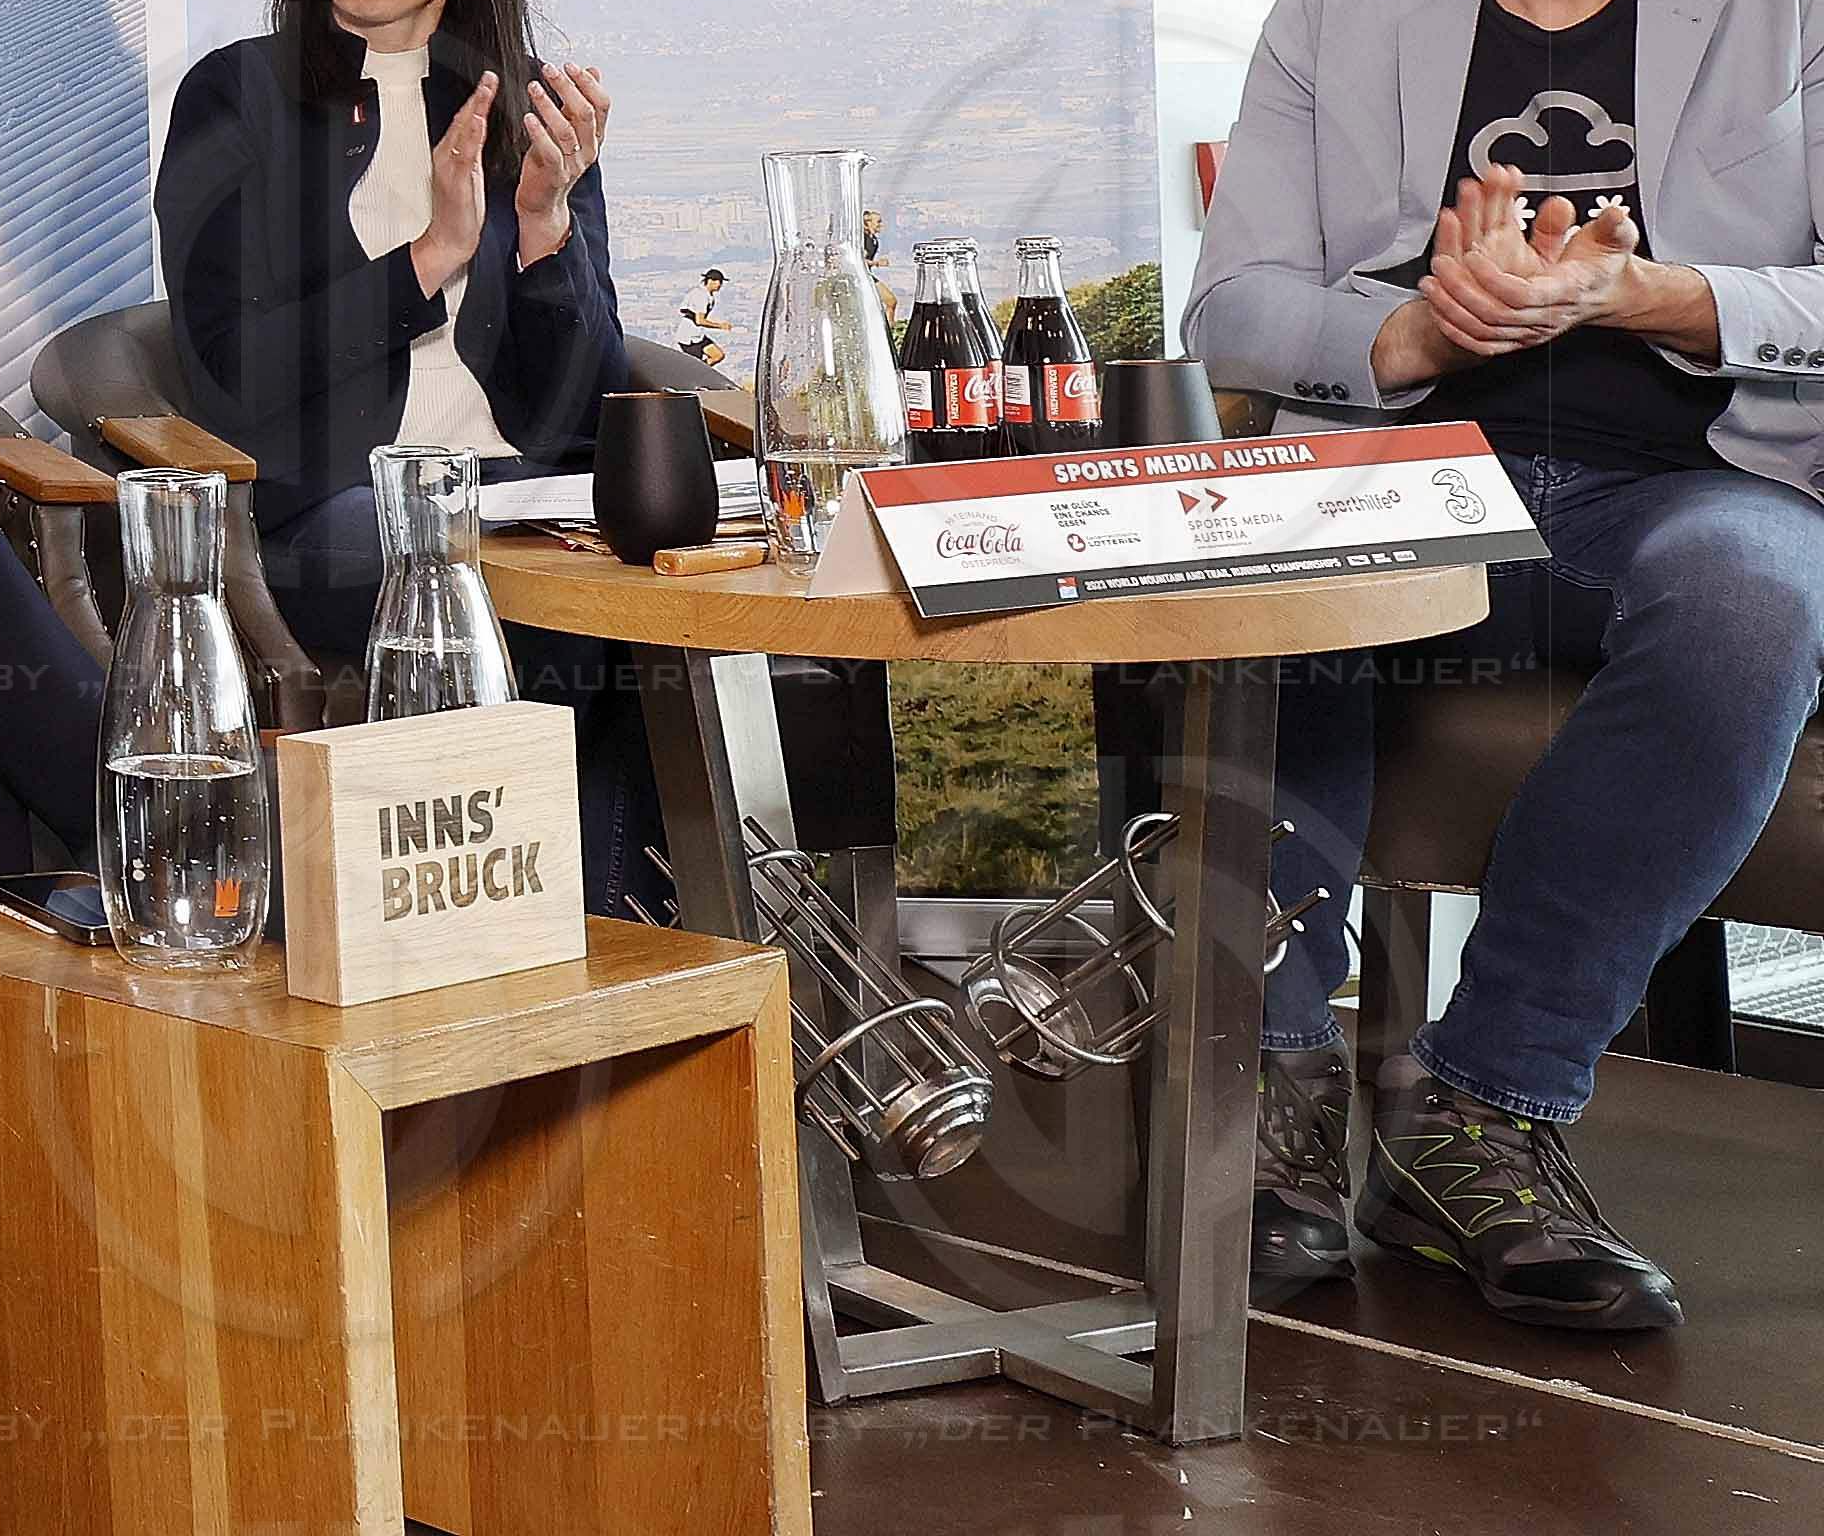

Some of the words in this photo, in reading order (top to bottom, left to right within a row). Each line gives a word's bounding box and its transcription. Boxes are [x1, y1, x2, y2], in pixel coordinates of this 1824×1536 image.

[1054, 457, 1139, 484] SPORTS
[1144, 453, 1218, 476] MEDIA
[1223, 444, 1316, 470] AUSTRIA
[1188, 517, 1238, 531] SPORTS
[1242, 514, 1284, 525] MEDIA
[1194, 530, 1248, 543] AUSTRIA
[381, 841, 544, 922] BRUCK
